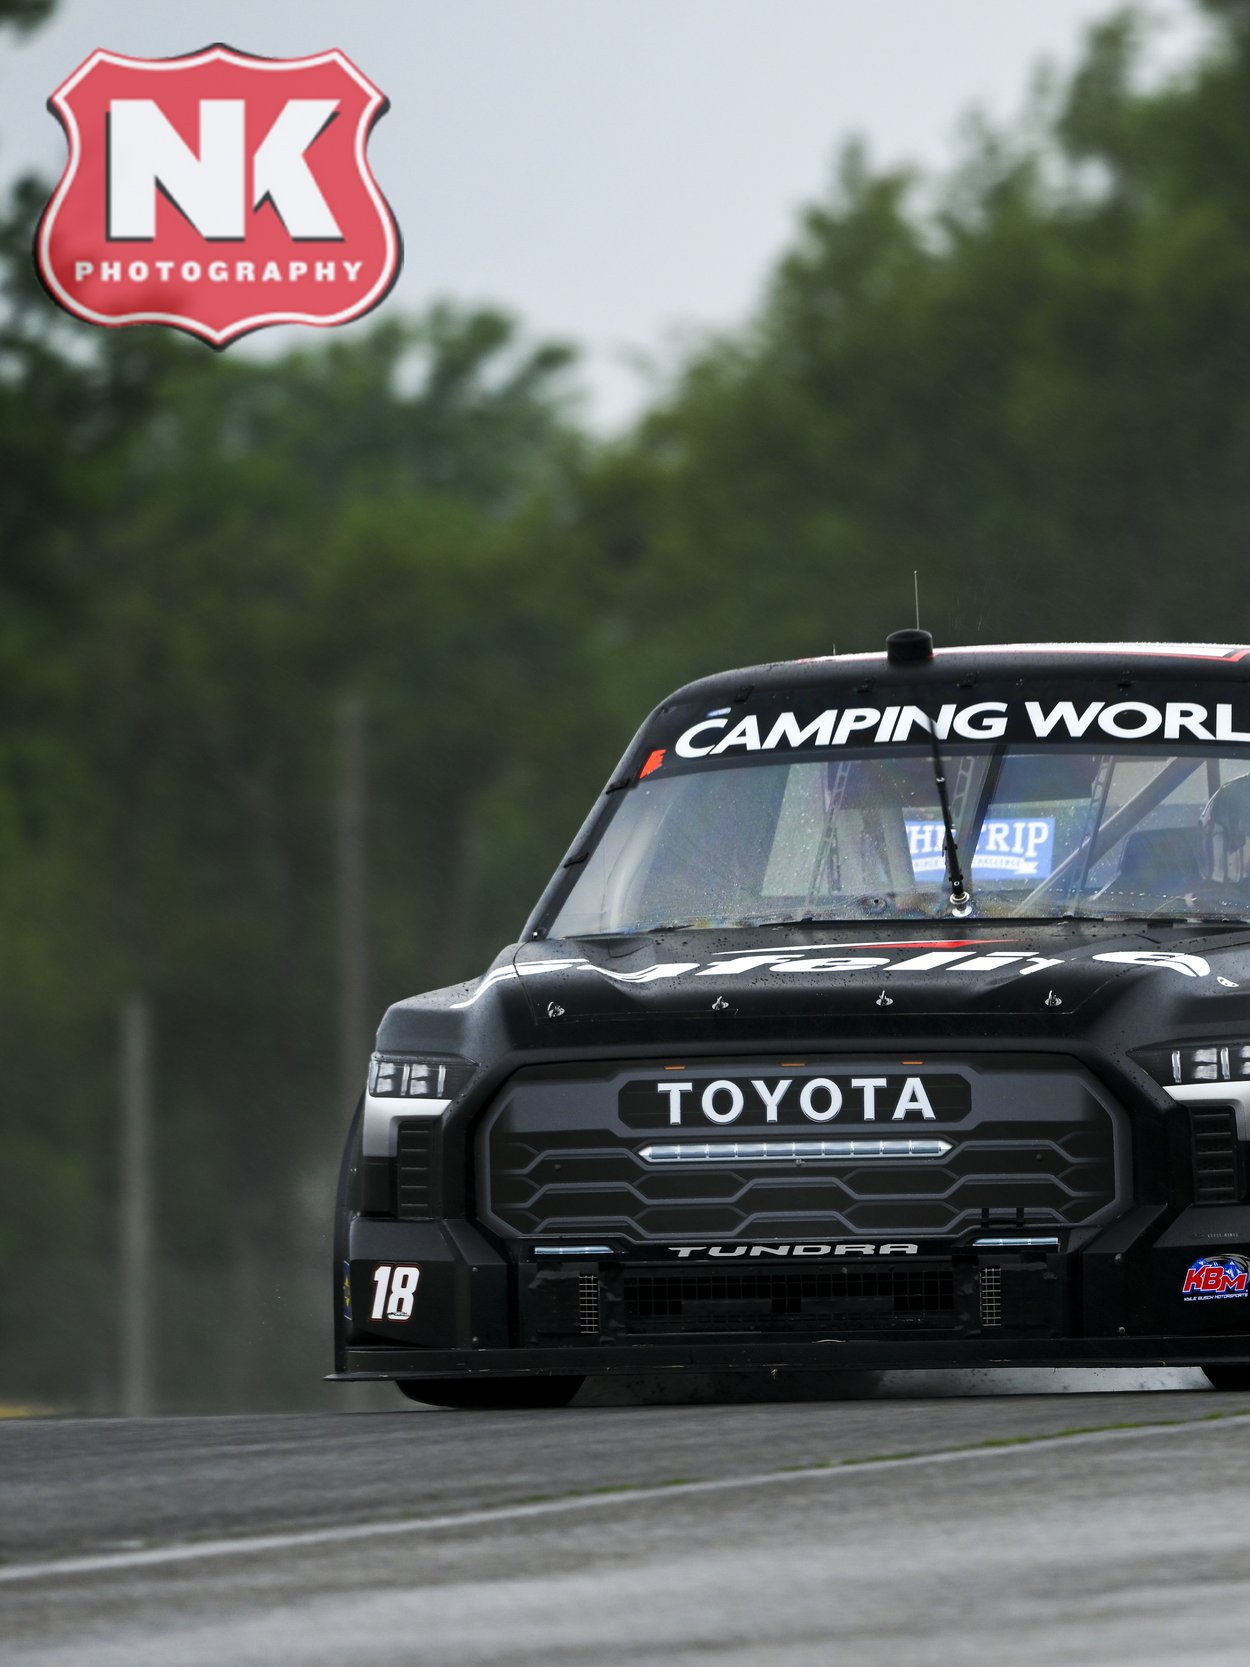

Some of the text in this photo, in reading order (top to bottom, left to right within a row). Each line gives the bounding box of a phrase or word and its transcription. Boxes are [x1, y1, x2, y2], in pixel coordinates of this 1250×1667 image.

[675, 701, 1008, 758] CAMPING
[657, 1077, 937, 1125] TOYOTA
[668, 1243, 919, 1258] TUNDRA
[371, 1265, 420, 1320] 18
[1182, 1265, 1249, 1294] KBM
